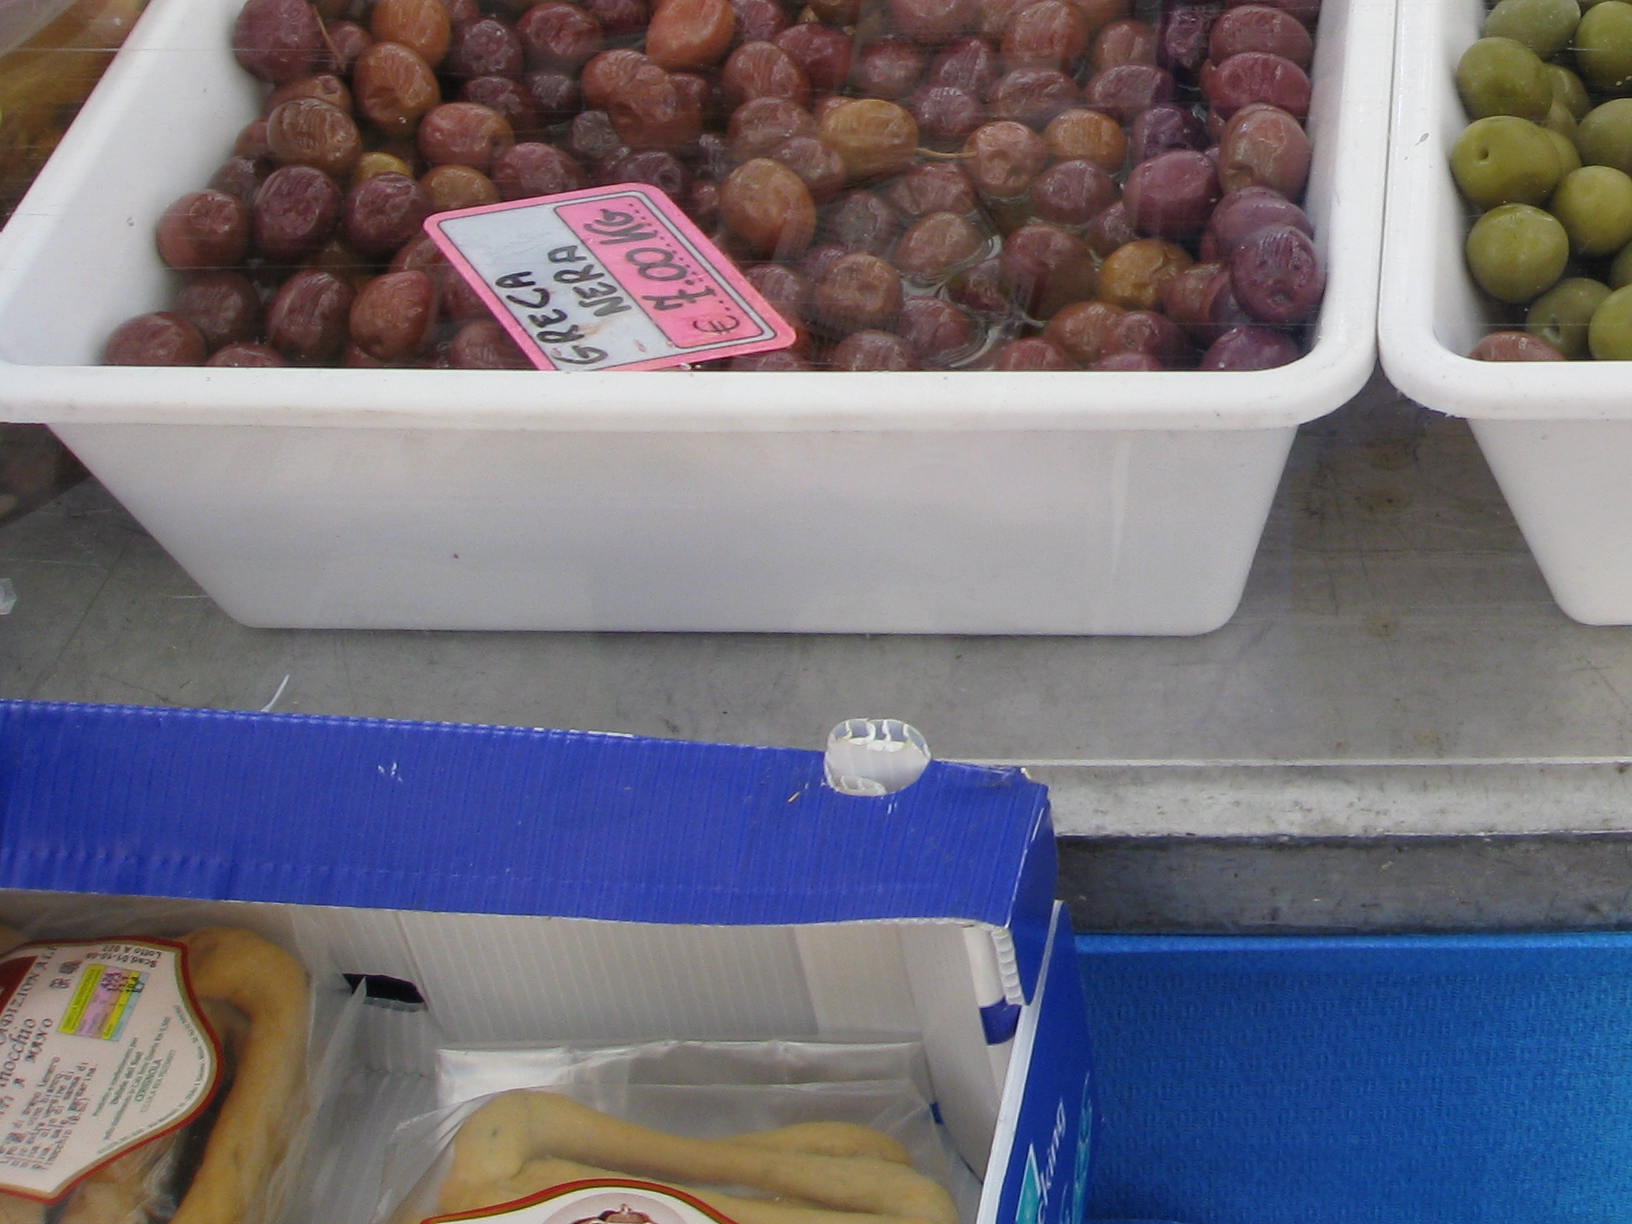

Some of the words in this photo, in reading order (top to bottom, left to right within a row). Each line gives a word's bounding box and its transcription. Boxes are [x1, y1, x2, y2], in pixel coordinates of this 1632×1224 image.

[583, 208, 658, 246] KG
[547, 243, 632, 318] NERA
[625, 247, 717, 311] 7.00
[494, 270, 609, 366] GRECA
[692, 314, 740, 335] €
[0, 1019, 36, 1087] inocchio
